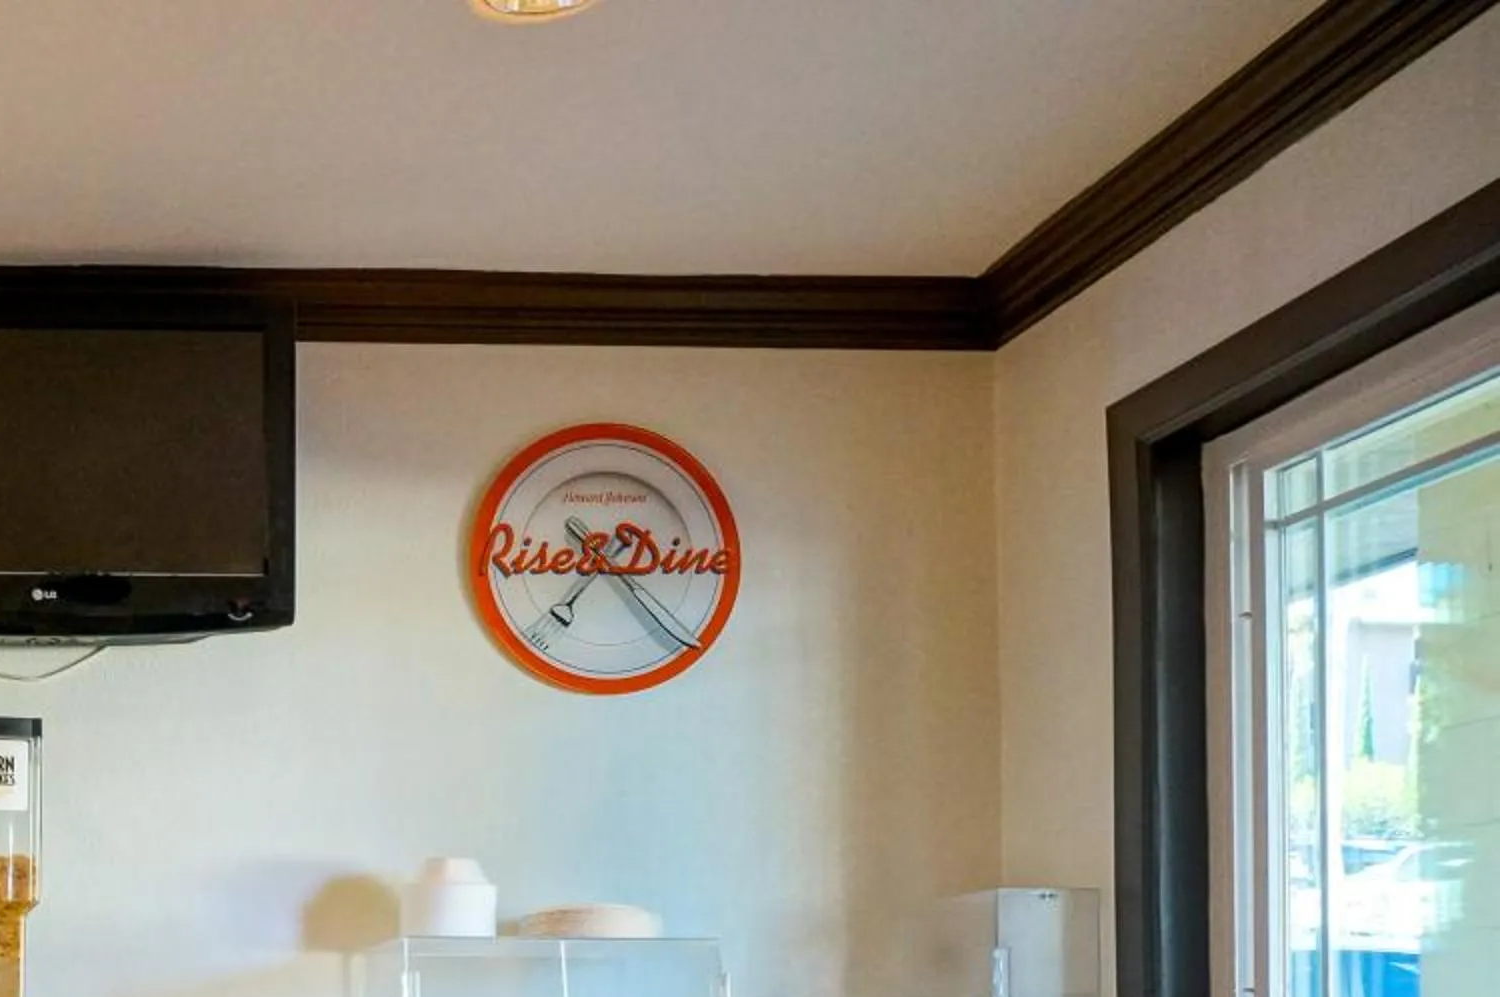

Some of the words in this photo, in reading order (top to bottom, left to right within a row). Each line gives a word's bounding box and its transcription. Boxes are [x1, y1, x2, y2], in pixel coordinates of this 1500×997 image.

[481, 522, 579, 578] Rise
[574, 531, 612, 575] &
[609, 522, 733, 575] Dine
